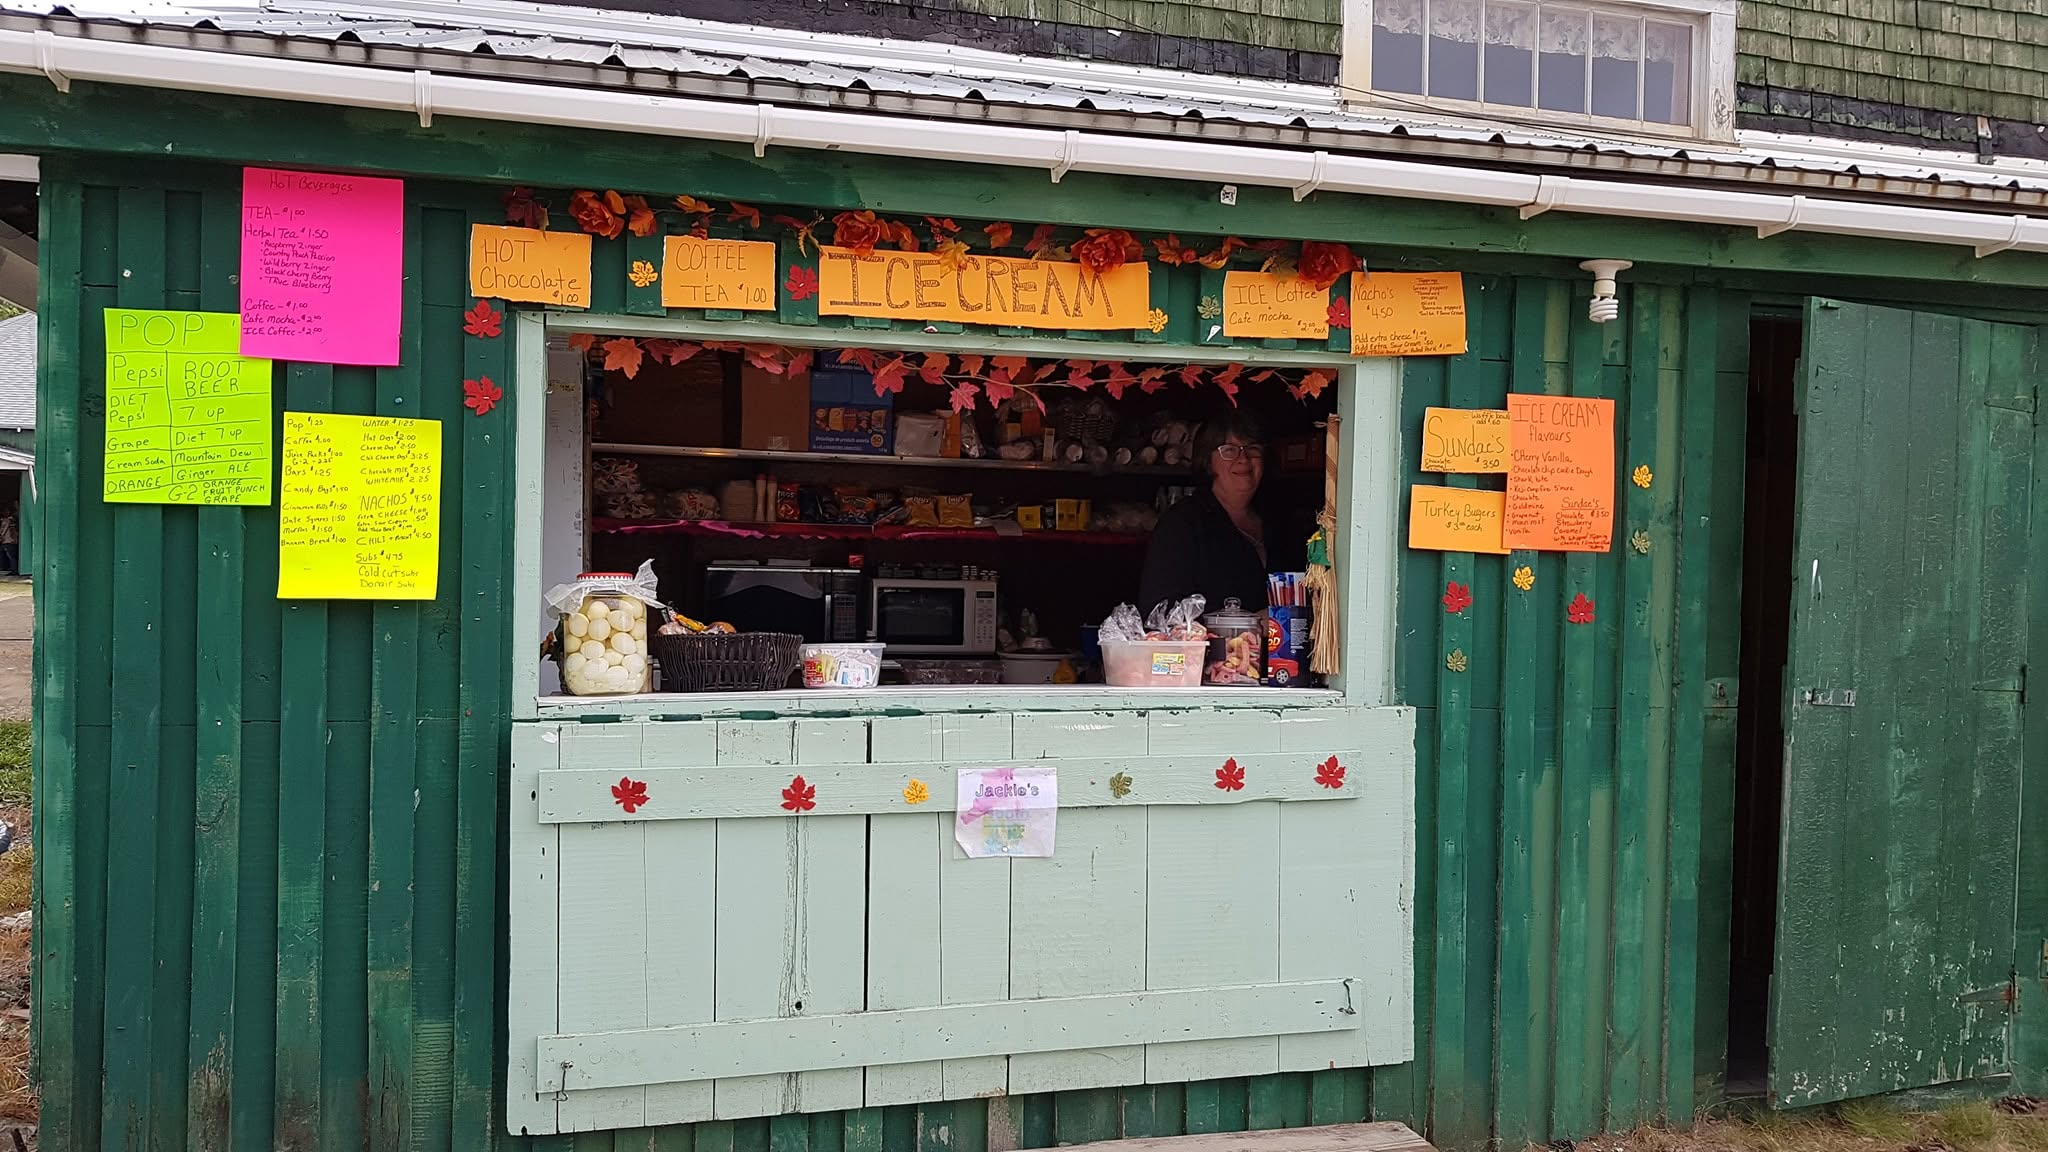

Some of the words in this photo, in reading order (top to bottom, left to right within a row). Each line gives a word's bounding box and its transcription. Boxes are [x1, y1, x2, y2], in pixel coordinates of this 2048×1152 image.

[298, 175, 353, 195] Beverages
[244, 223, 276, 238] Herbal
[278, 227, 300, 239] Tea
[263, 248, 290, 261] Country
[483, 239, 535, 264] HOT
[675, 241, 749, 272] COFFEE
[303, 262, 330, 273] Zinger
[311, 272, 332, 285] Berry
[479, 266, 583, 291] Chocolate
[828, 251, 946, 310] ICE
[957, 257, 1114, 318] CREAM
[292, 279, 331, 294] Blueberry
[680, 284, 729, 303] TEA
[1231, 284, 1268, 306] ICE
[1275, 281, 1318, 303] Coffee
[1353, 283, 1395, 301] Nacho's
[244, 298, 276, 311] Coffee
[243, 312, 264, 323] Cafe
[1229, 311, 1252, 325] Cafe
[121, 314, 205, 346] POP
[242, 327, 265, 335] ICE
[267, 326, 296, 336] Coffee
[1354, 333, 1369, 343] Add
[1369, 331, 1388, 343] extra
[1354, 343, 1369, 352] Add
[113, 355, 164, 389] Pepsi
[184, 360, 247, 379] ROOT
[184, 378, 240, 398] BEER
[110, 392, 149, 408] DIET
[109, 405, 146, 428] Pepsi
[178, 406, 195, 421] 7
[206, 409, 225, 421] up
[1512, 403, 1546, 424] ICE
[1551, 402, 1601, 428] CREAM
[287, 418, 304, 432] Pop
[362, 419, 390, 427] WATER
[175, 431, 207, 445] Diet
[215, 428, 225, 440] 7
[229, 429, 243, 440] up
[1529, 424, 1572, 443] flavours
[107, 437, 150, 451] Grape
[174, 452, 222, 463] Mountain
[229, 448, 252, 457] Dew
[1542, 451, 1573, 463] Vanilla
[106, 459, 143, 470] Cream
[145, 457, 166, 465] Soda
[285, 465, 306, 476] Bars
[176, 468, 216, 481] Ginger
[228, 462, 251, 474] ALE
[1576, 466, 1593, 477] Dough
[106, 477, 161, 493] ORANGE
[202, 479, 243, 489] ORANGE
[203, 486, 233, 497] FRUIT
[235, 484, 265, 493] PUNCH
[283, 483, 313, 495] Candy
[168, 484, 198, 501] G-2
[204, 494, 241, 504] GRAPE
[360, 495, 407, 511] NACHOS
[377, 509, 408, 519] CHEESE
[1418, 500, 1460, 522] Turkey
[282, 516, 301, 525] Date
[1466, 524, 1483, 532] each
[309, 537, 330, 545] Bread
[356, 536, 386, 545] CHILI
[355, 552, 378, 562] Subs
[358, 565, 380, 577] Cold
[359, 579, 393, 588] Donair
[975, 783, 1040, 798] Jackie's
